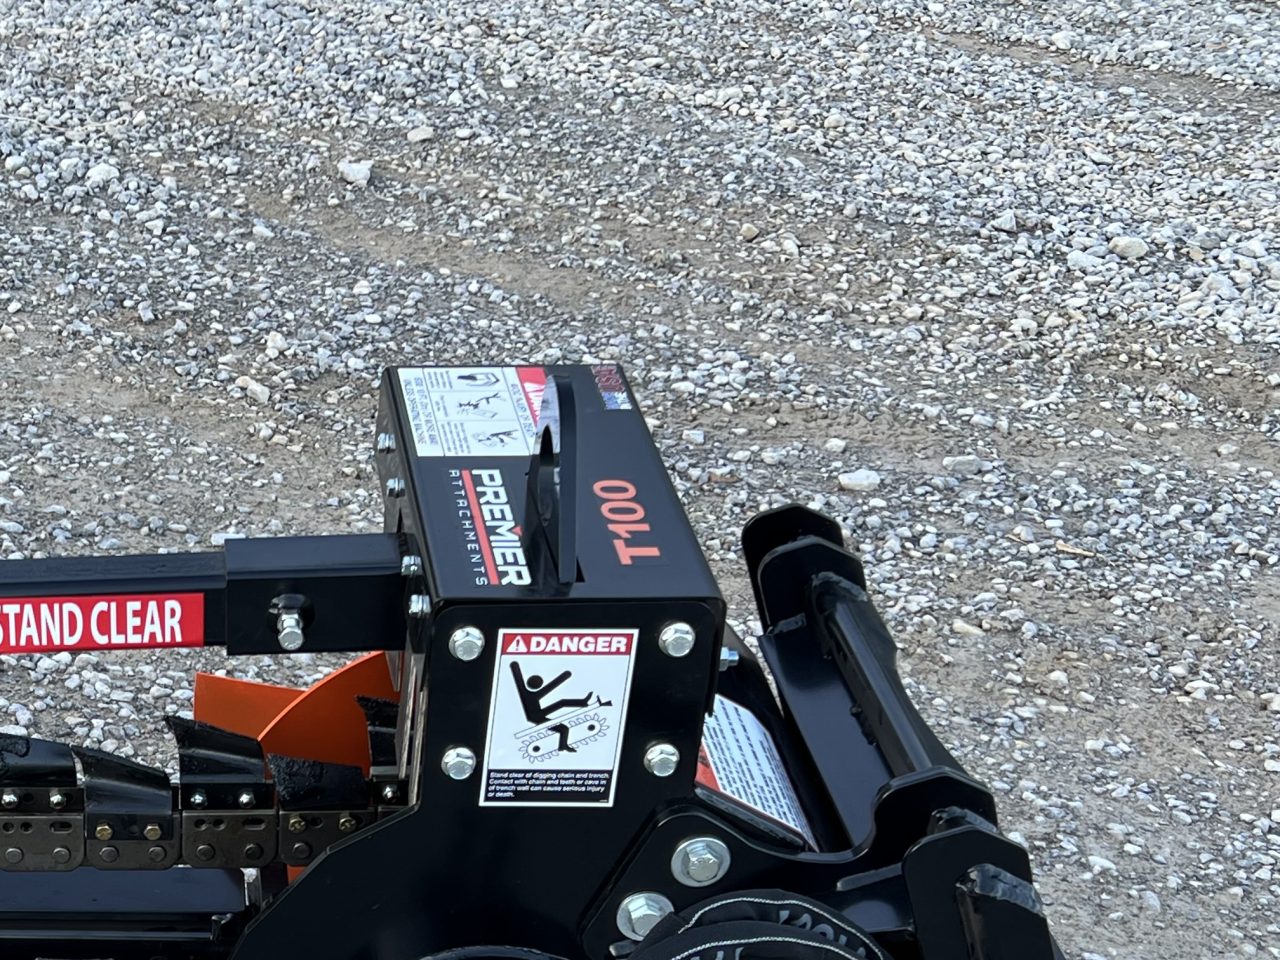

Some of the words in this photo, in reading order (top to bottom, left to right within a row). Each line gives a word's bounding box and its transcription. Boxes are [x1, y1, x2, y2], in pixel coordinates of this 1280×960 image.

[448, 469, 488, 586] ATTACHMENTS
[472, 468, 532, 586] PREMIER
[592, 479, 661, 566] T100
[90, 599, 182, 644] CLEAR
[529, 636, 627, 653] DANGER
